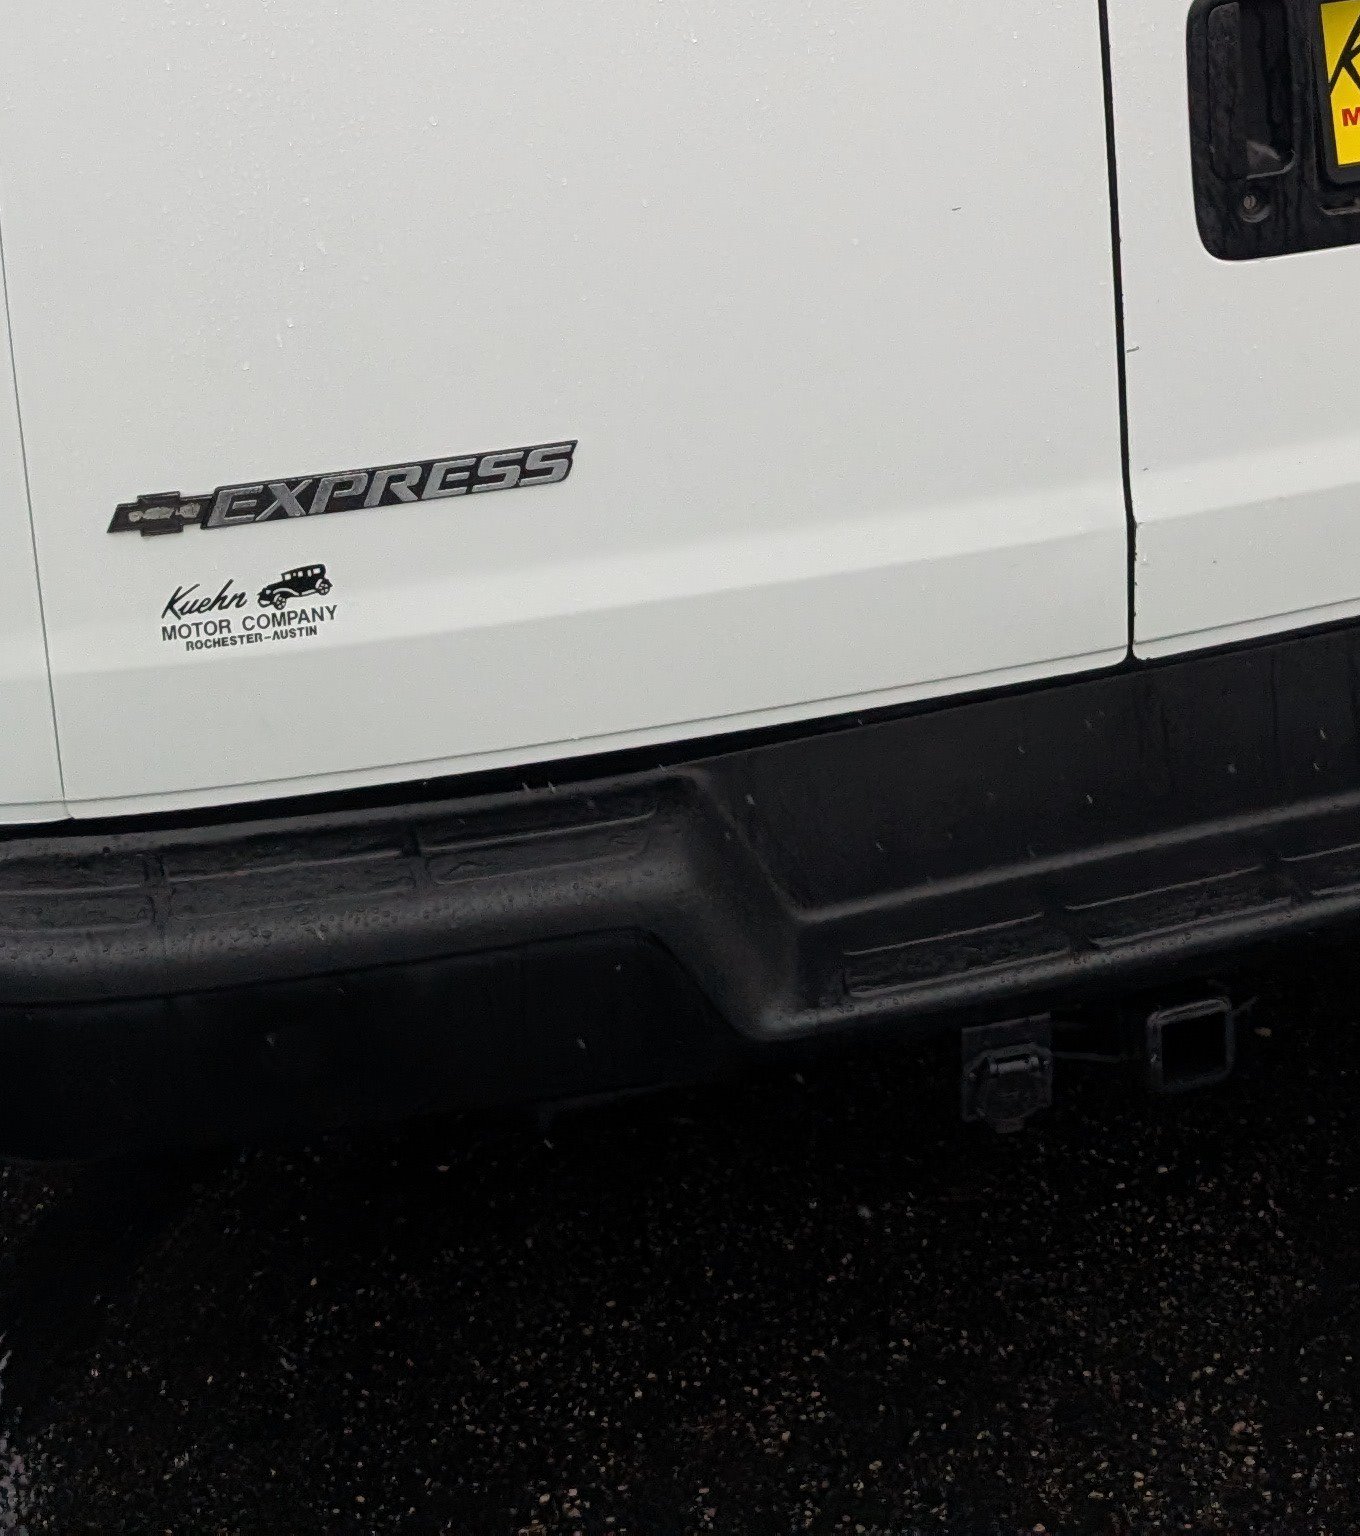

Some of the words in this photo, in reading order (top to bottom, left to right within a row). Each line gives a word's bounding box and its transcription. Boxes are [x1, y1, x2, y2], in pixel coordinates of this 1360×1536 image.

[206, 443, 573, 528] EXPRESS
[161, 578, 247, 620] Kuehn
[162, 618, 232, 641] MOTOR
[242, 604, 338, 632] COMPANY
[186, 625, 317, 651] ROCHESTER-AUSTIN
